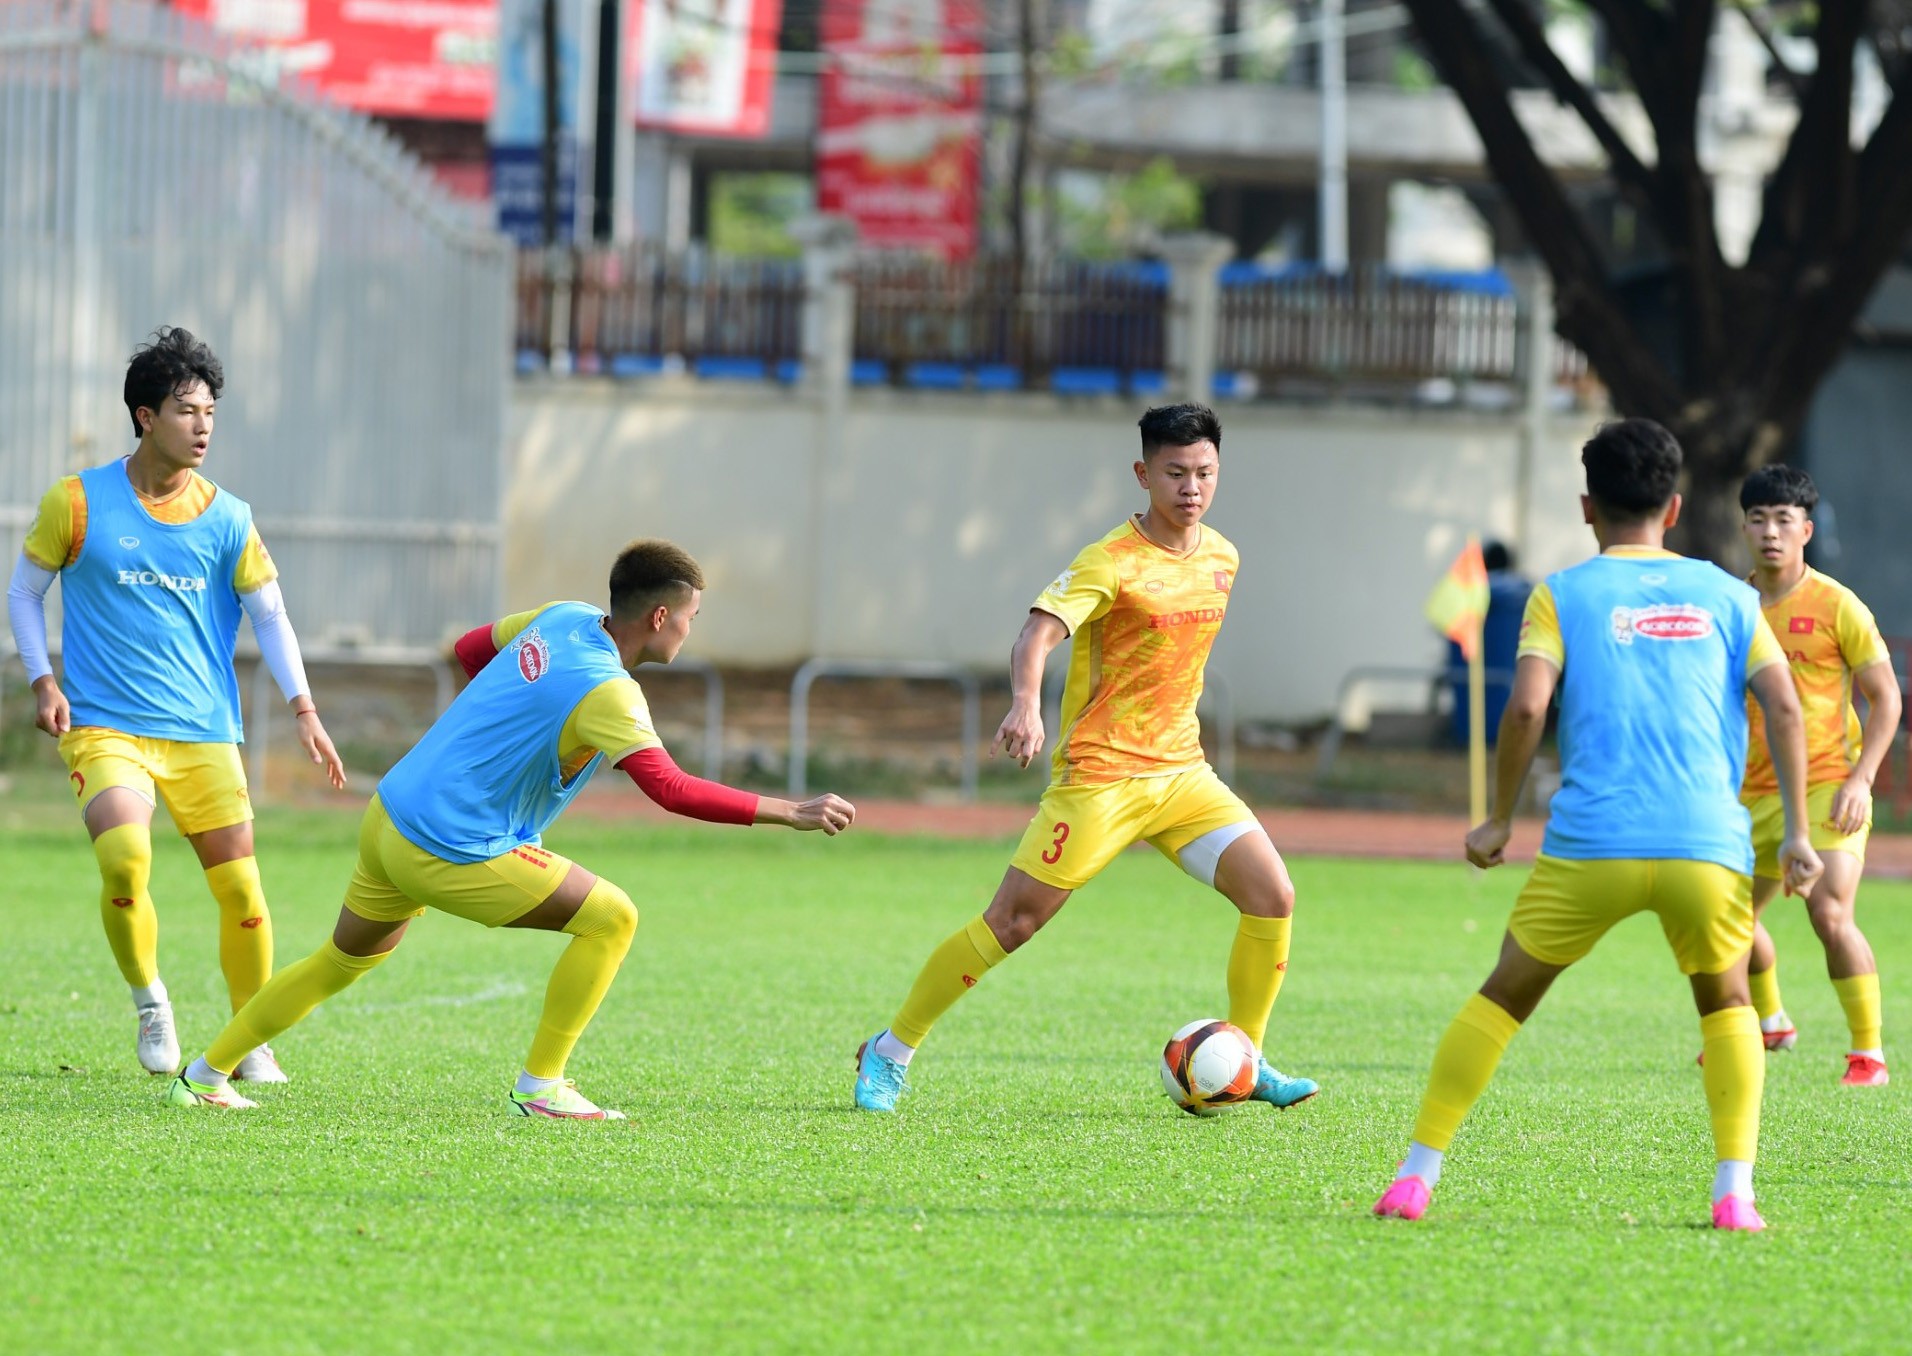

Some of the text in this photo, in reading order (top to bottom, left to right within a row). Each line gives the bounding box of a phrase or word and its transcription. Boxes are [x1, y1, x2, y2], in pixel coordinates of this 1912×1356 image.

[117, 570, 206, 592] HONDA
[1148, 608, 1223, 629] HONDA
[1041, 821, 1070, 865] 3
